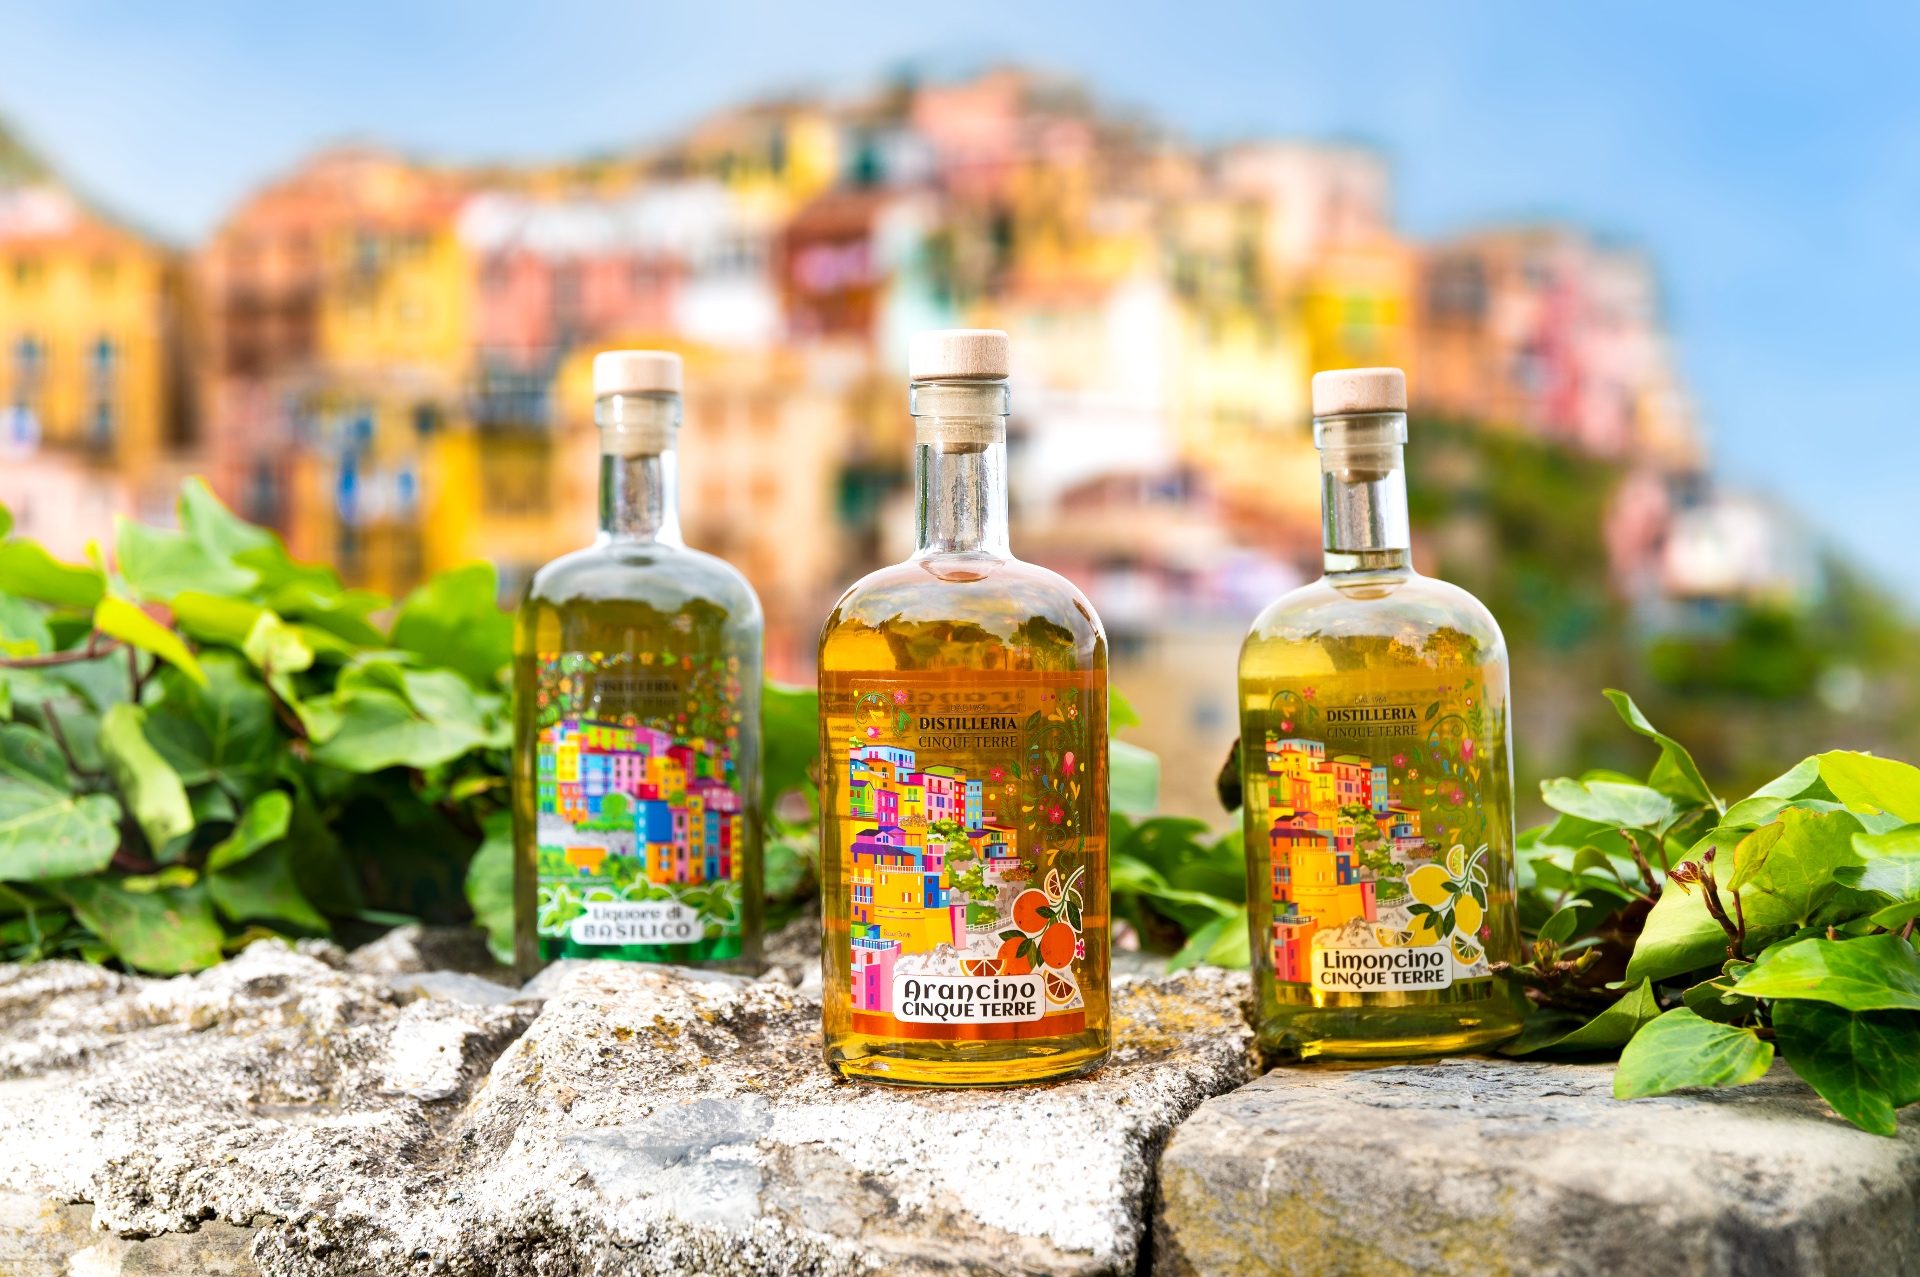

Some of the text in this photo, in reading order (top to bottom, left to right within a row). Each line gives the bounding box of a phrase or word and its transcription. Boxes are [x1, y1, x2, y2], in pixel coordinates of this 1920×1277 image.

[1326, 707, 1417, 723] DISTILLERIA
[919, 716, 1017, 731] DISTILLERIA
[1326, 724, 1419, 739] CINQUE TERRE
[918, 735, 1018, 751] CINQUE TERRE
[593, 906, 683, 921] Liquore di
[584, 922, 692, 939] BASILICO
[1323, 948, 1444, 971] Limoncino
[1320, 969, 1445, 990] CINQUE TERRE
[904, 978, 1036, 1003] Arancino
[902, 1000, 1037, 1022] CINQUE TERRE
